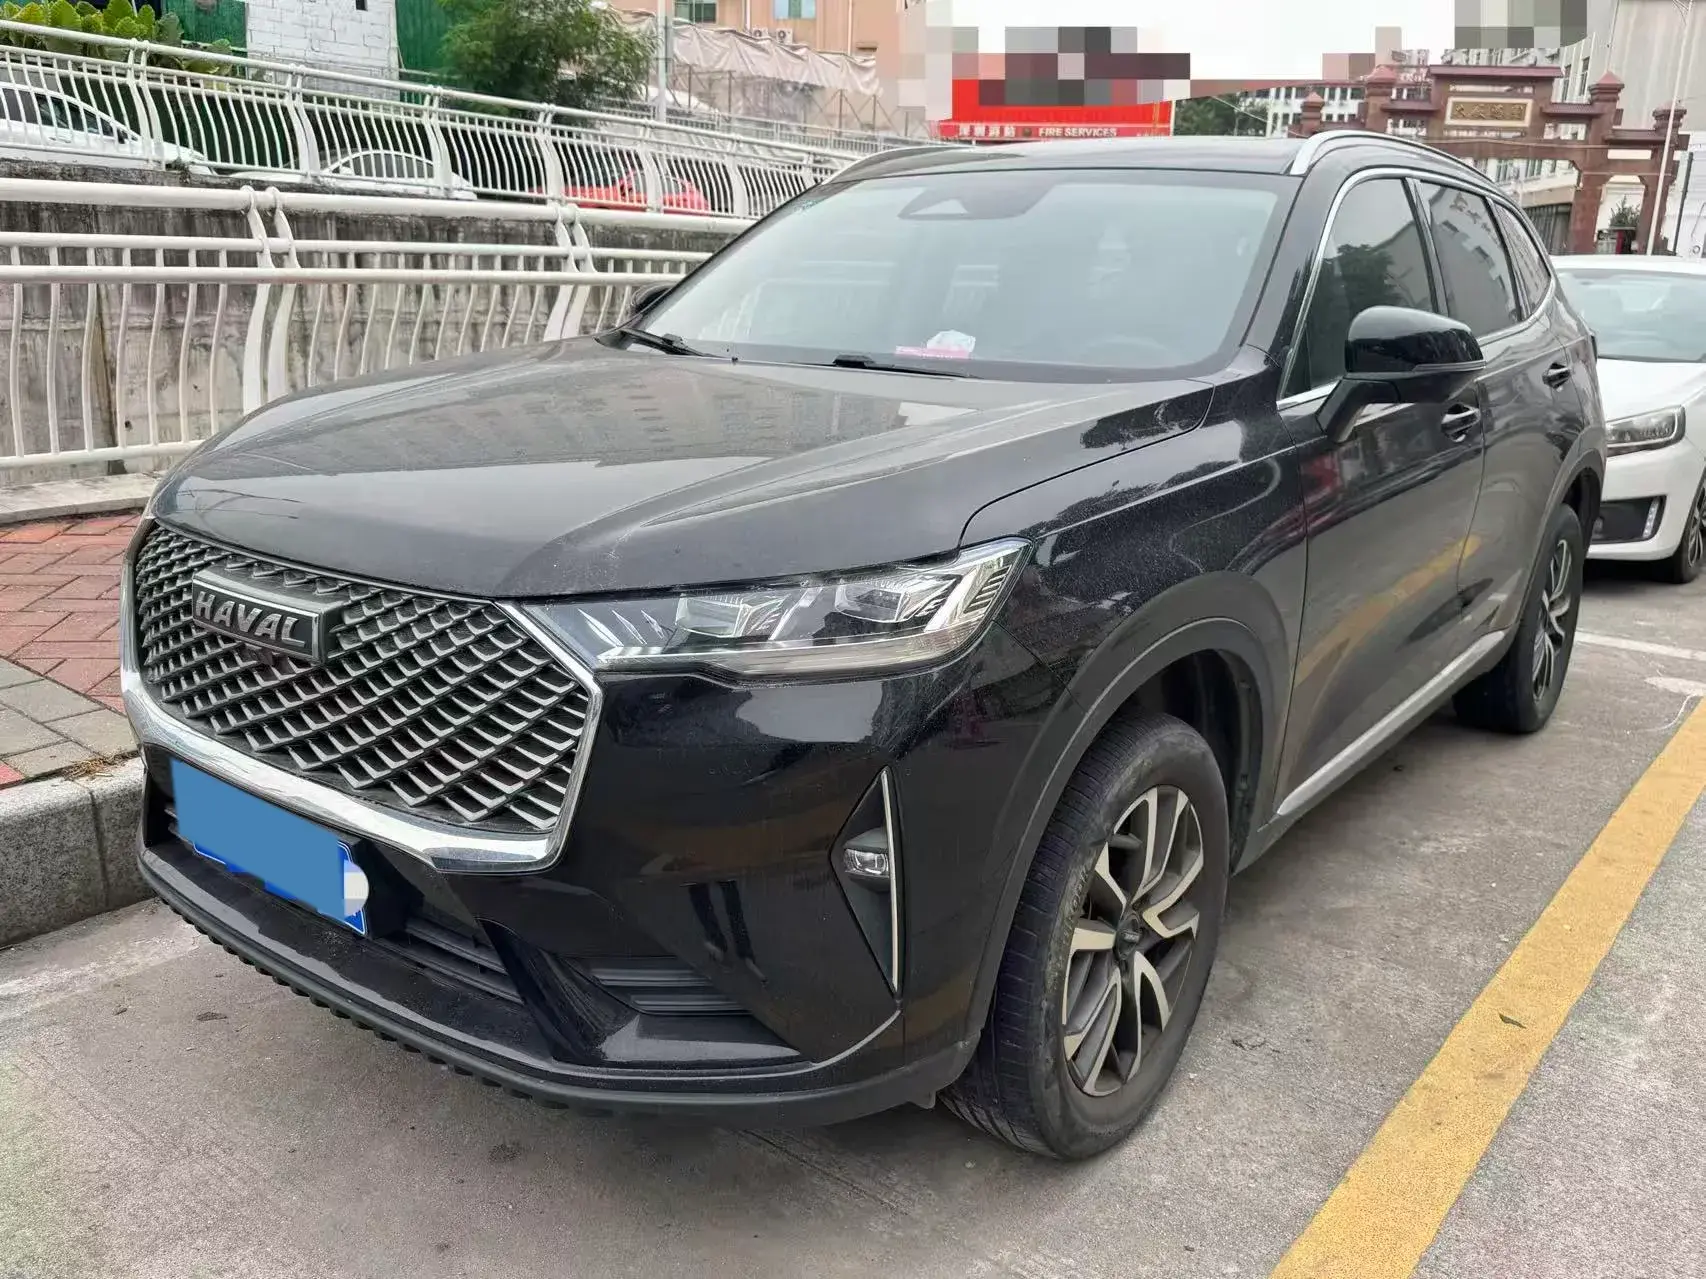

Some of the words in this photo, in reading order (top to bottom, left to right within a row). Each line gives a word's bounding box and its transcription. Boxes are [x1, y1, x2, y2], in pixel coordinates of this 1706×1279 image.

[1038, 127, 1063, 137] FIRE
[1064, 127, 1117, 137] SERVICES
[195, 590, 306, 648] HAVAL
